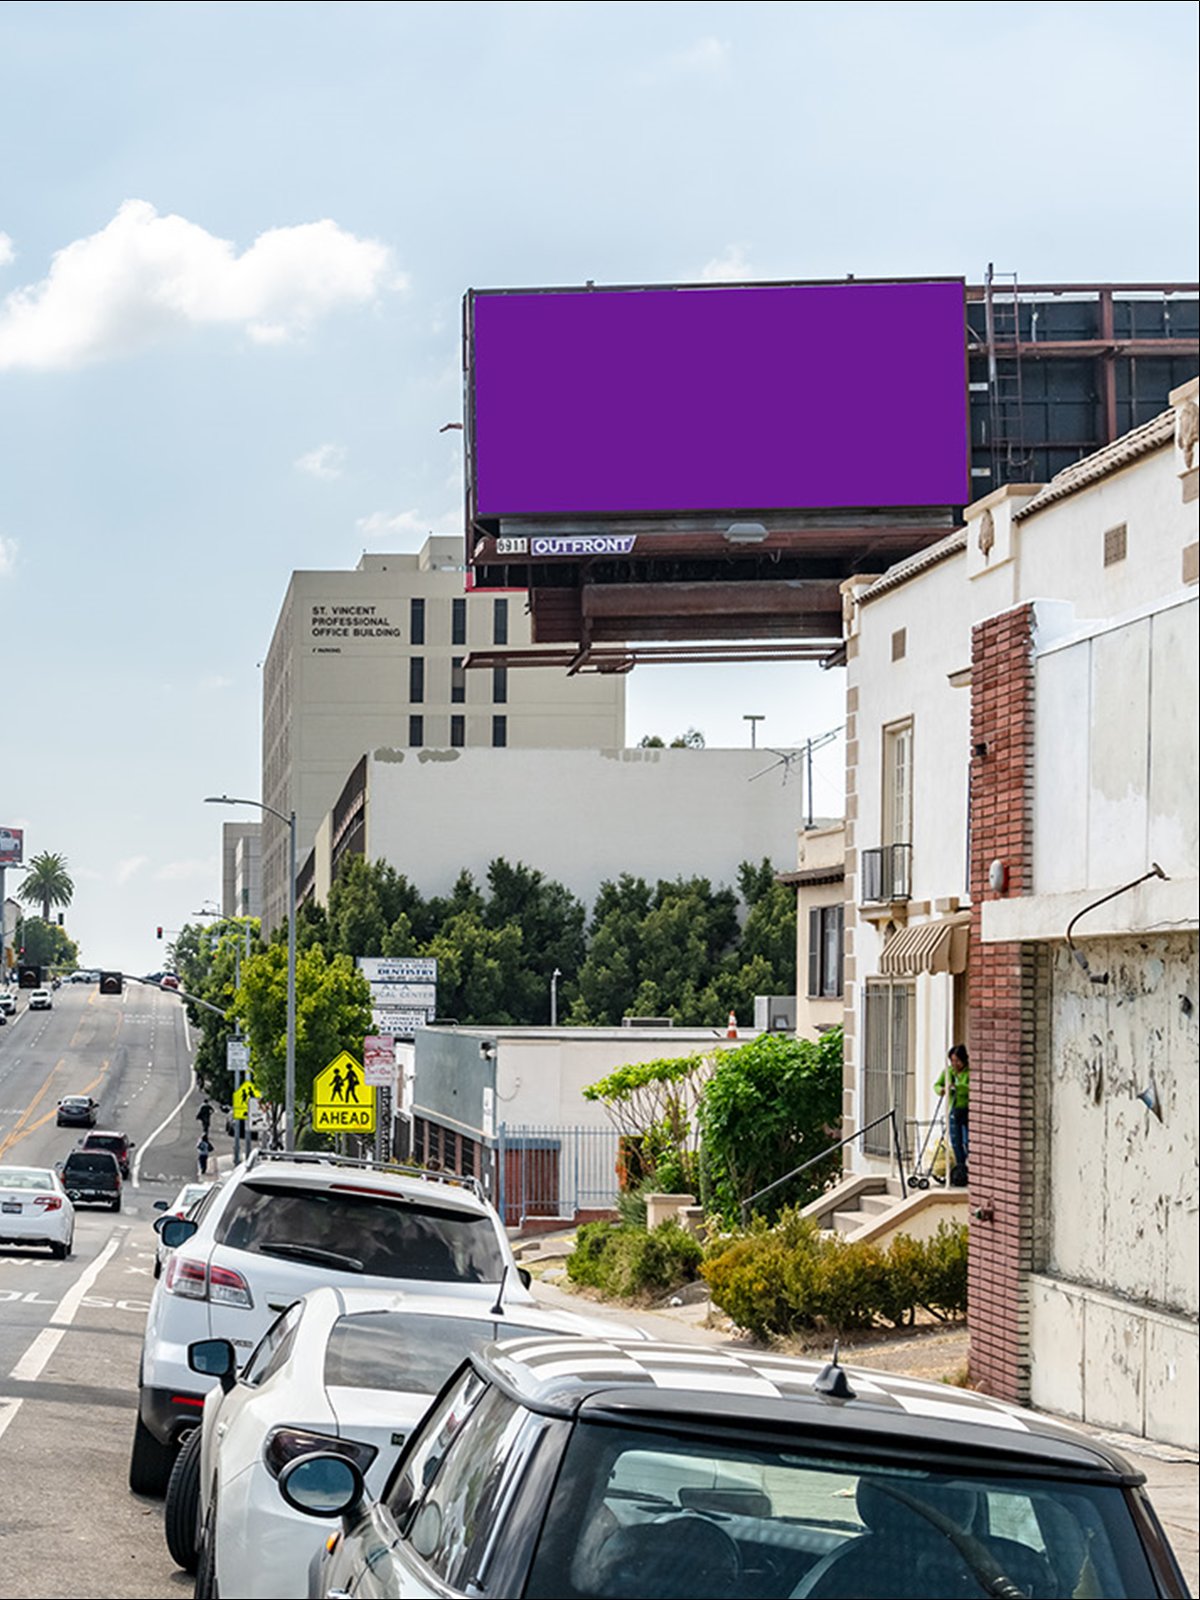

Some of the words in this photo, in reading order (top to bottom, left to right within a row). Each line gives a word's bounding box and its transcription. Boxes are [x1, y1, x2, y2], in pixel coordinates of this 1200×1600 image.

[498, 539, 526, 552] 6911
[535, 538, 630, 554] OUTFRONT
[312, 606, 327, 616] ST.
[331, 606, 376, 616] VINCENT
[312, 617, 389, 626] PROFESSIONAL
[312, 628, 349, 637] OFFICE
[353, 628, 401, 637] BUILDING
[319, 1111, 370, 1125] AHEAD
